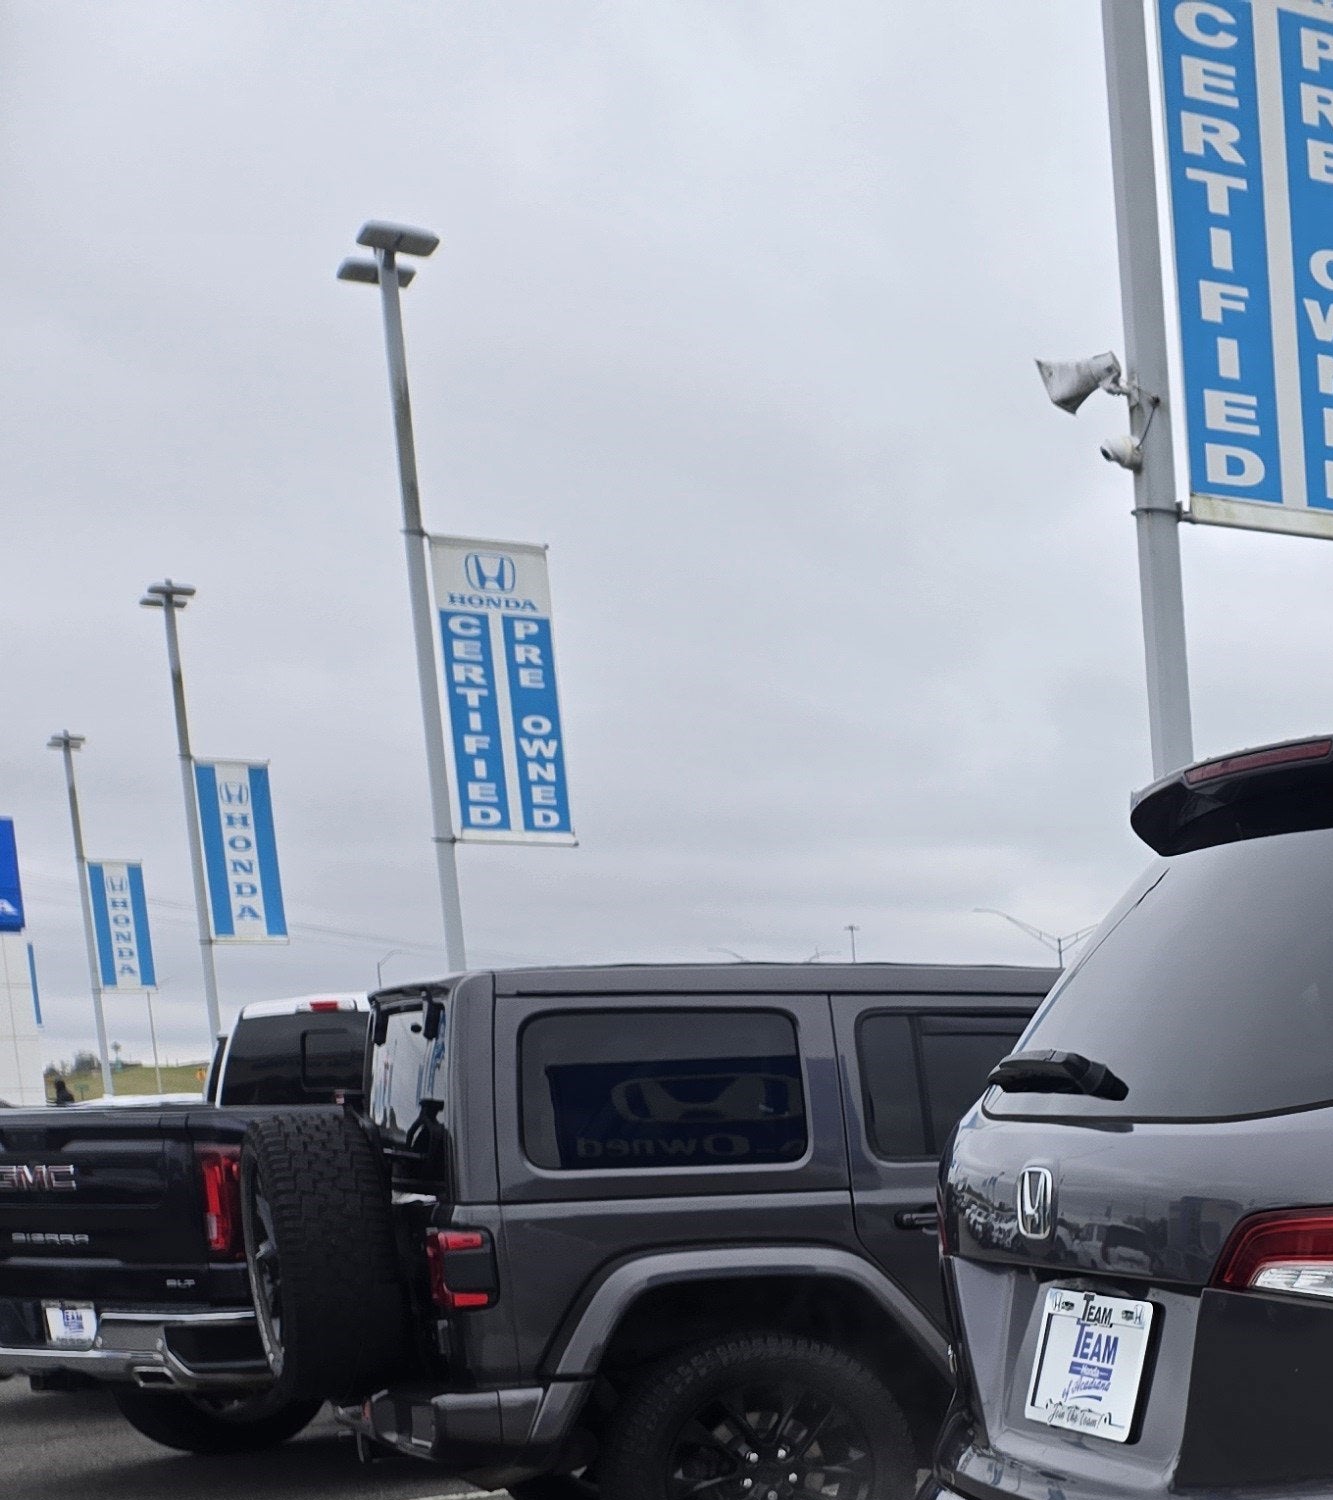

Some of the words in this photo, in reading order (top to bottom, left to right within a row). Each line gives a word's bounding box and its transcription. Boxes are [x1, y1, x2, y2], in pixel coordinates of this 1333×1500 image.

[1174, 0, 1266, 488] CERTIFIED
[448, 592, 537, 612] HONDA
[514, 620, 545, 690] PRE
[448, 615, 501, 827] CERTIFIED
[519, 714, 560, 829] OWNED
[224, 811, 261, 921] HONDA
[111, 897, 137, 976] HONDA
[11, 1232, 90, 1245] SIERRA
